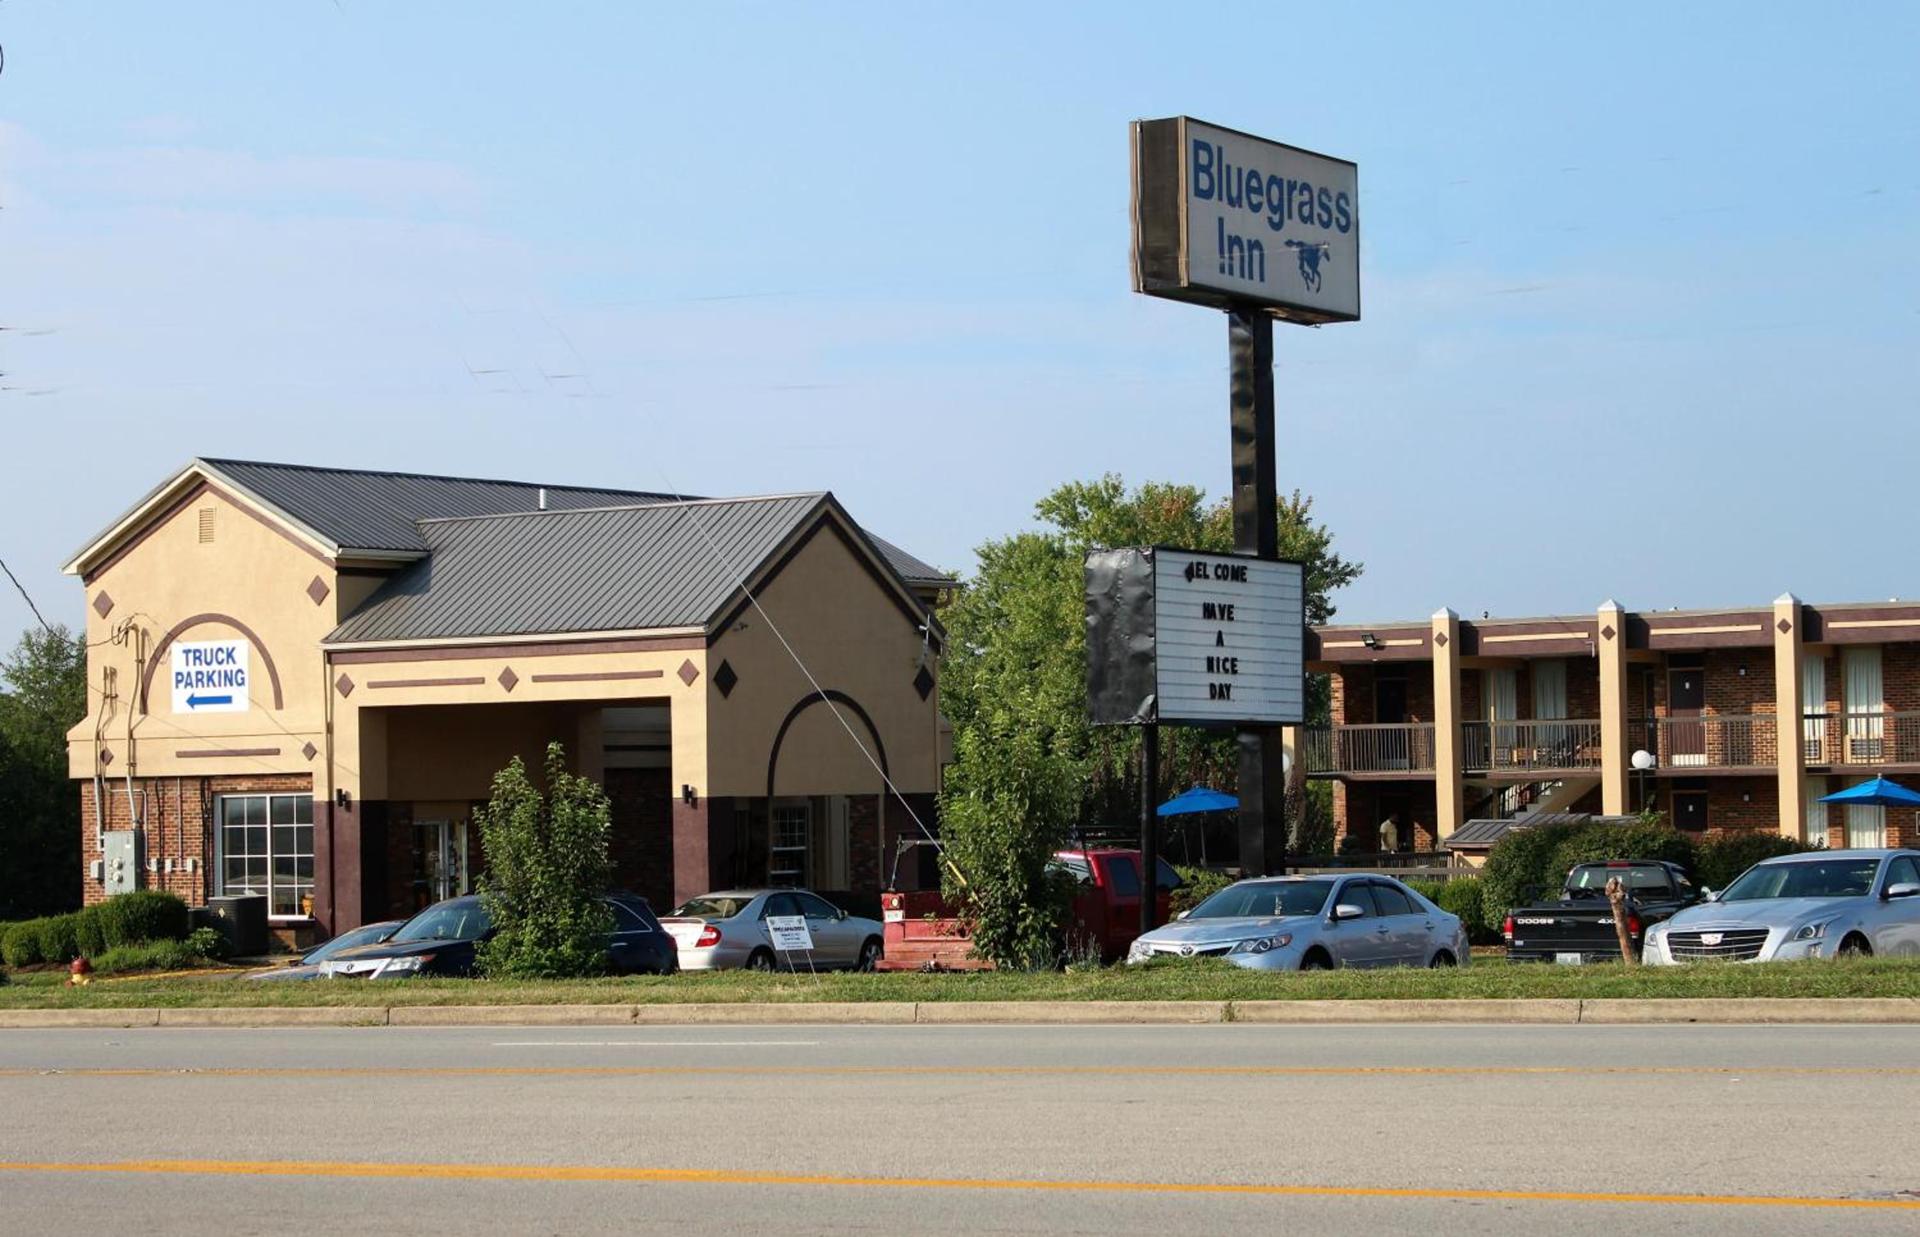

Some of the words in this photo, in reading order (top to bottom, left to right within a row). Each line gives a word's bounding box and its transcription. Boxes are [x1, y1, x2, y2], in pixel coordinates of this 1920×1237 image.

[1193, 139, 1350, 233] Bluegrass
[1218, 217, 1265, 282] Inn
[1203, 602, 1234, 621] HAVE
[1216, 630, 1224, 647] A
[182, 647, 236, 667] TRUCK
[1207, 656, 1238, 674] NICE
[175, 669, 245, 689] PARKING
[1209, 683, 1231, 700] DAY
